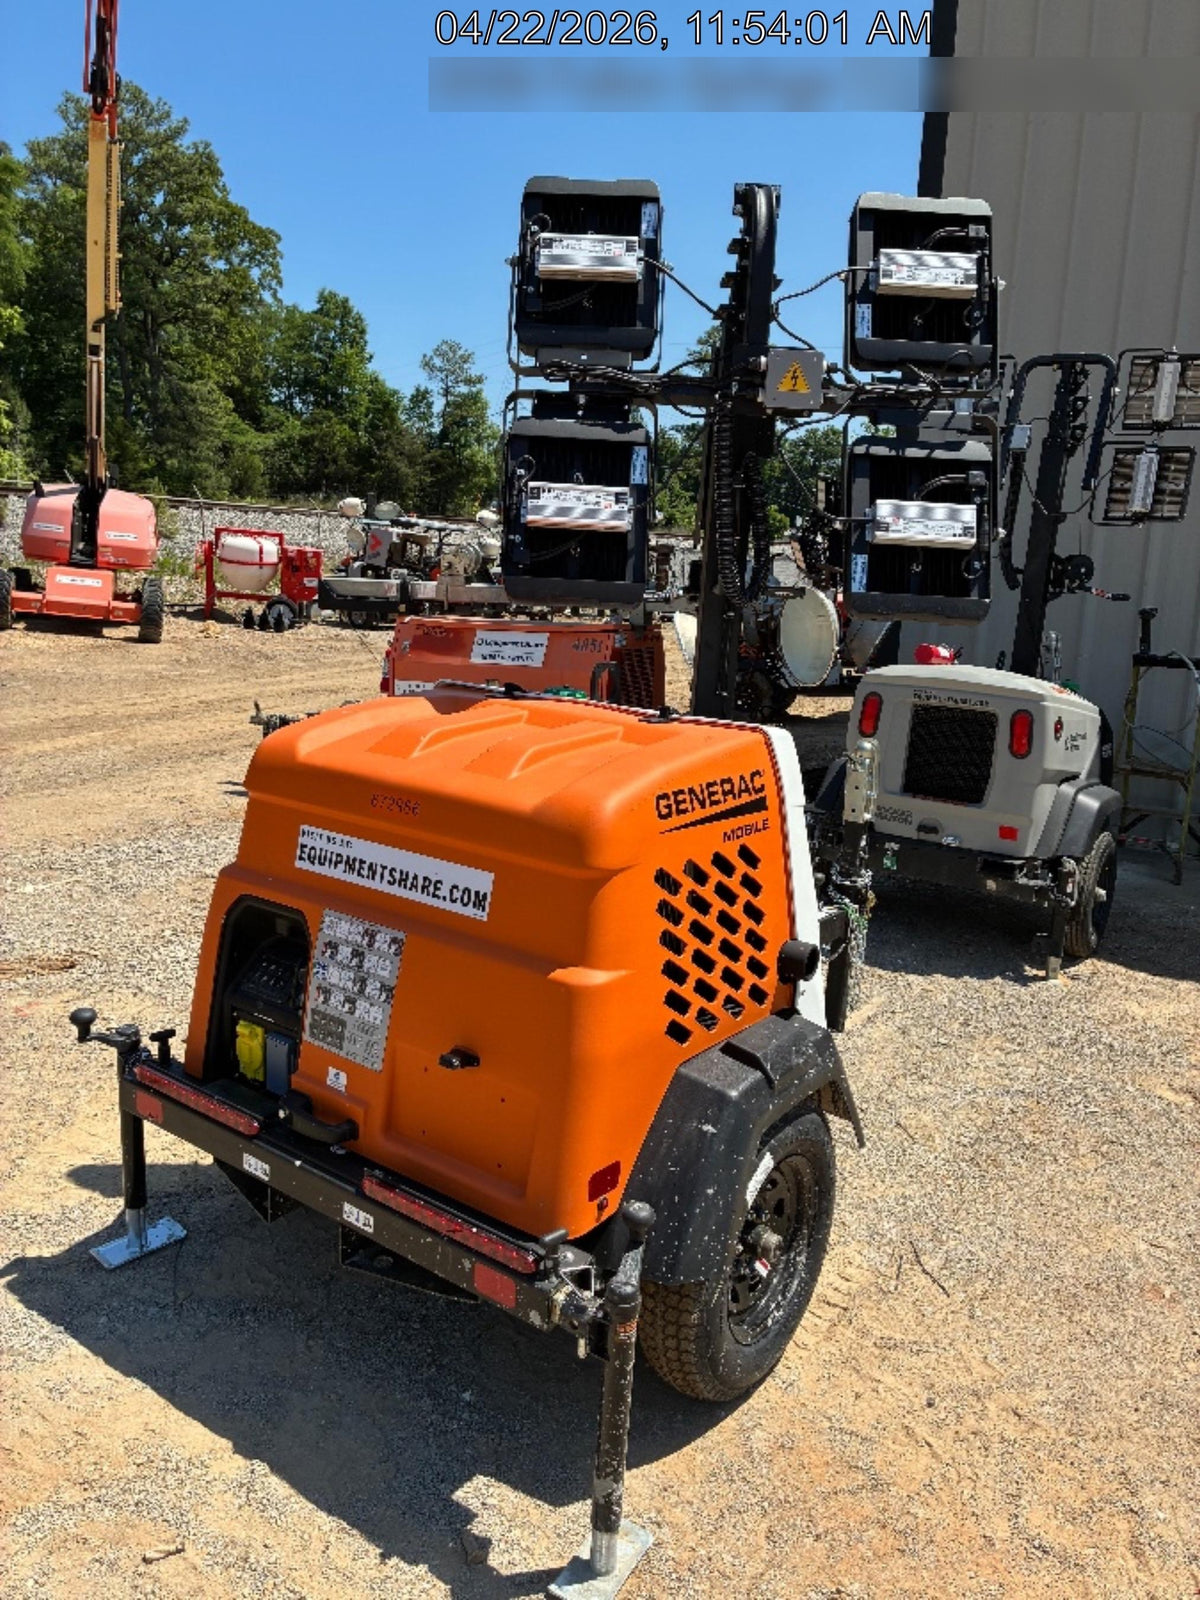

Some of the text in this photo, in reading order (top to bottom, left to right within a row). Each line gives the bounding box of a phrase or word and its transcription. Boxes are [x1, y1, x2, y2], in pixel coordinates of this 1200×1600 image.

[655, 769, 765, 820] GENERAC
[722, 818, 770, 843] MOBILE
[298, 843, 488, 913] EQUIPMENTSHARE.COM
